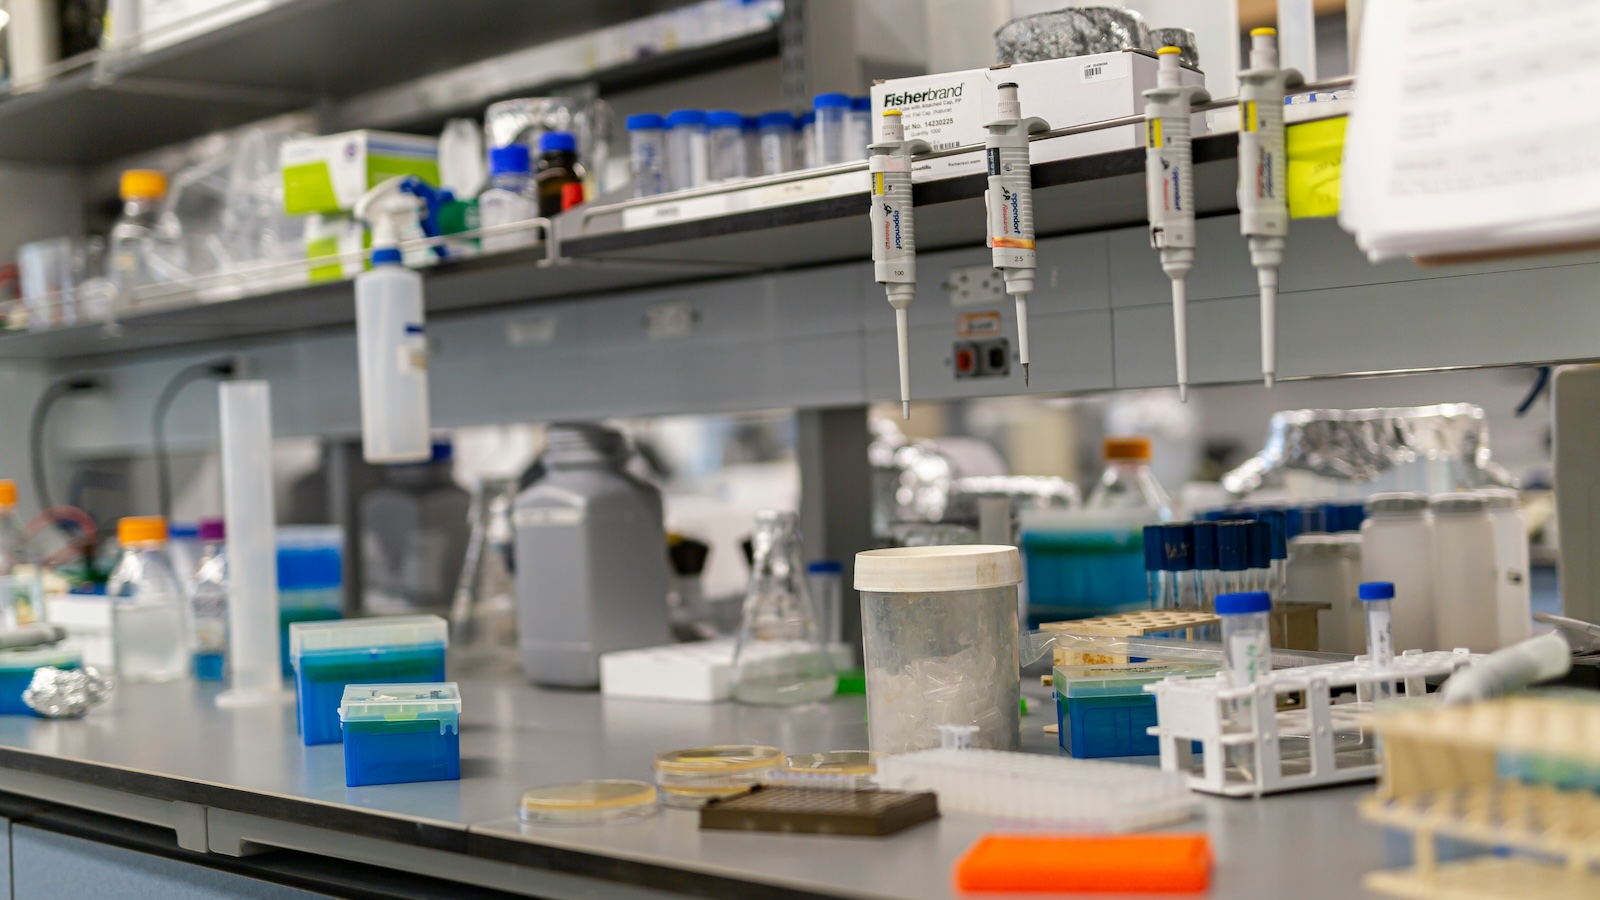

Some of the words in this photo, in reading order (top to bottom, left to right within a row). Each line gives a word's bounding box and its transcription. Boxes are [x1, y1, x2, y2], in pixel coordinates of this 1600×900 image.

[884, 83, 963, 107] Fisherbrand
[925, 117, 954, 127] 14230225
[1011, 193, 1020, 234] eppendorf
[893, 210, 902, 249] eppendorf
